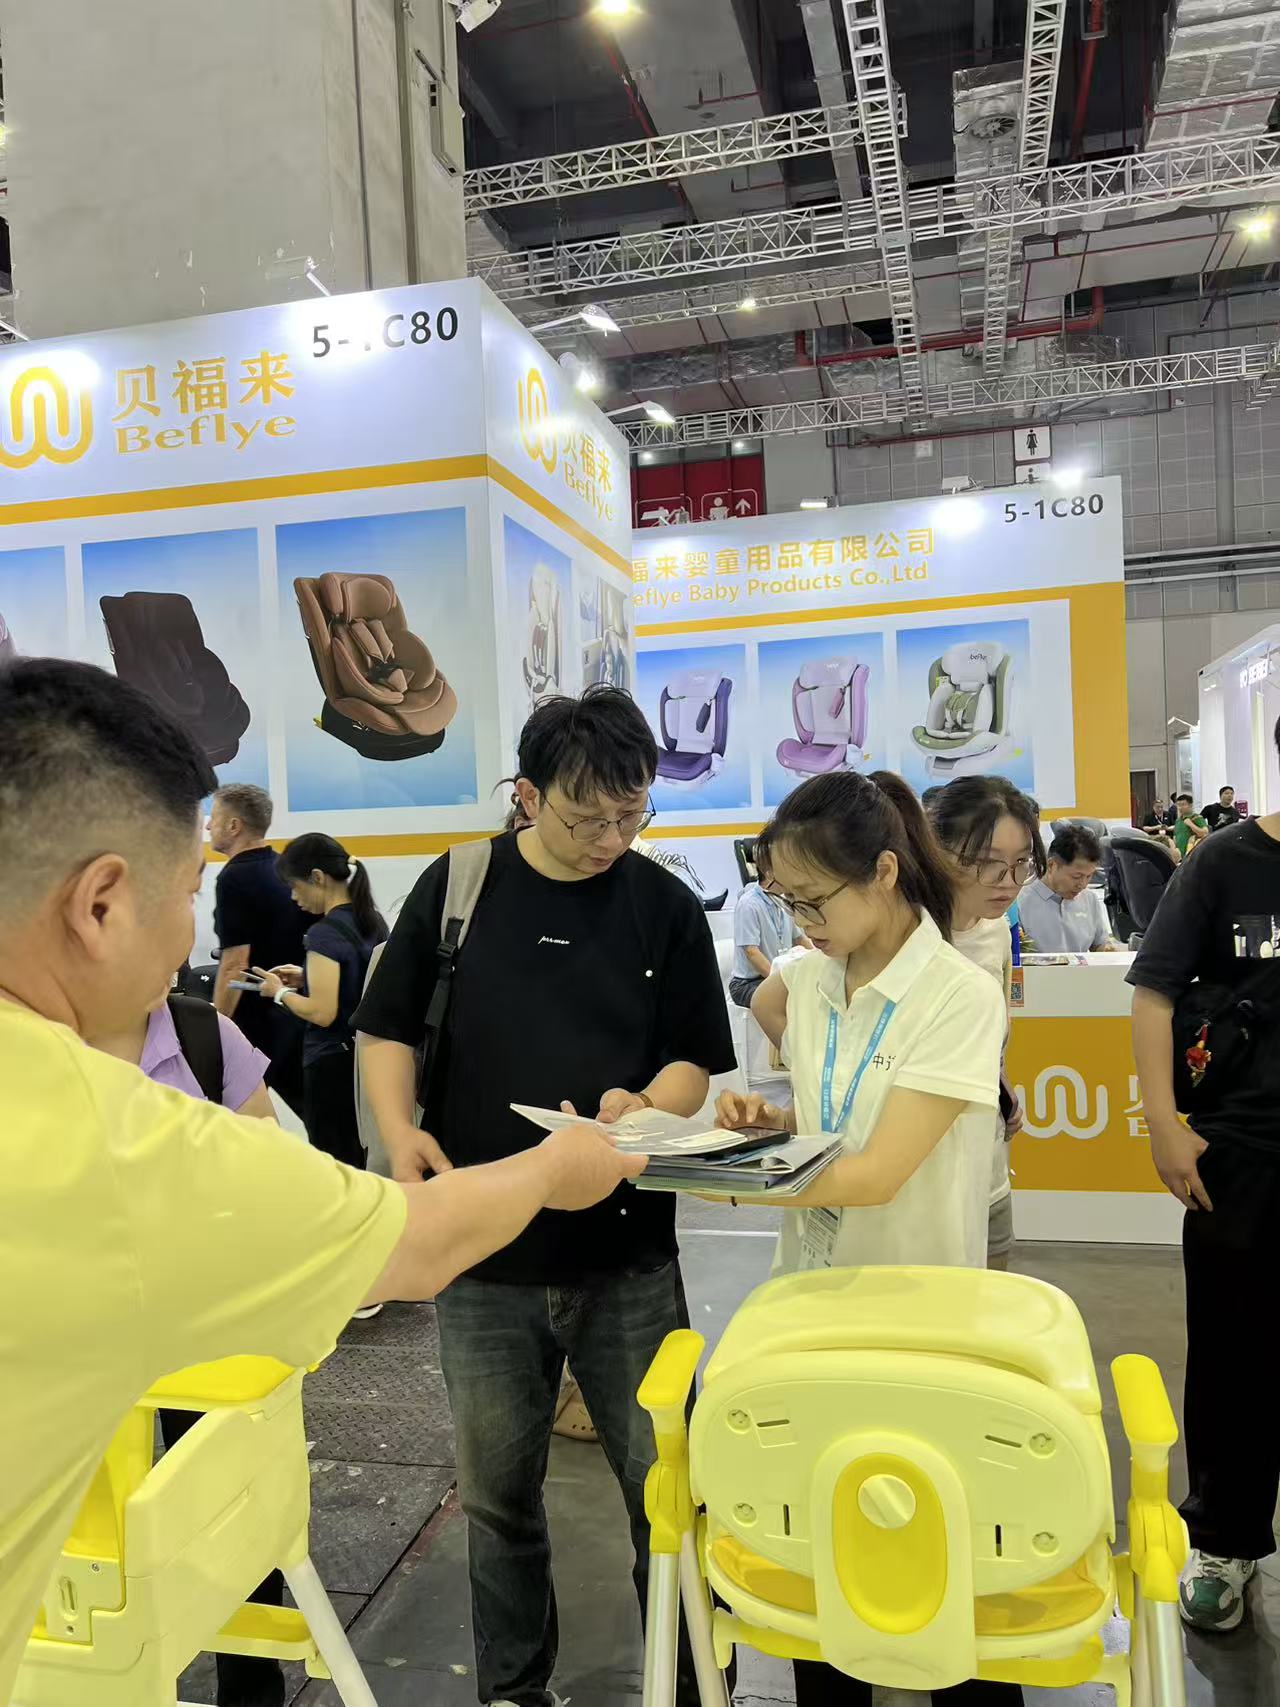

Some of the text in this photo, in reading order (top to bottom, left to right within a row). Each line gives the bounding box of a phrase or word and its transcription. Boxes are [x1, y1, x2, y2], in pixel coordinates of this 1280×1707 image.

[312, 306, 459, 359] 5-C80
[111, 350, 297, 422] 贝福来
[114, 412, 297, 455] Beflye
[1004, 493, 1104, 524] 5-1C80
[632, 586, 683, 609] eflye
[688, 580, 743, 604] Baby
[747, 569, 842, 597] Products
